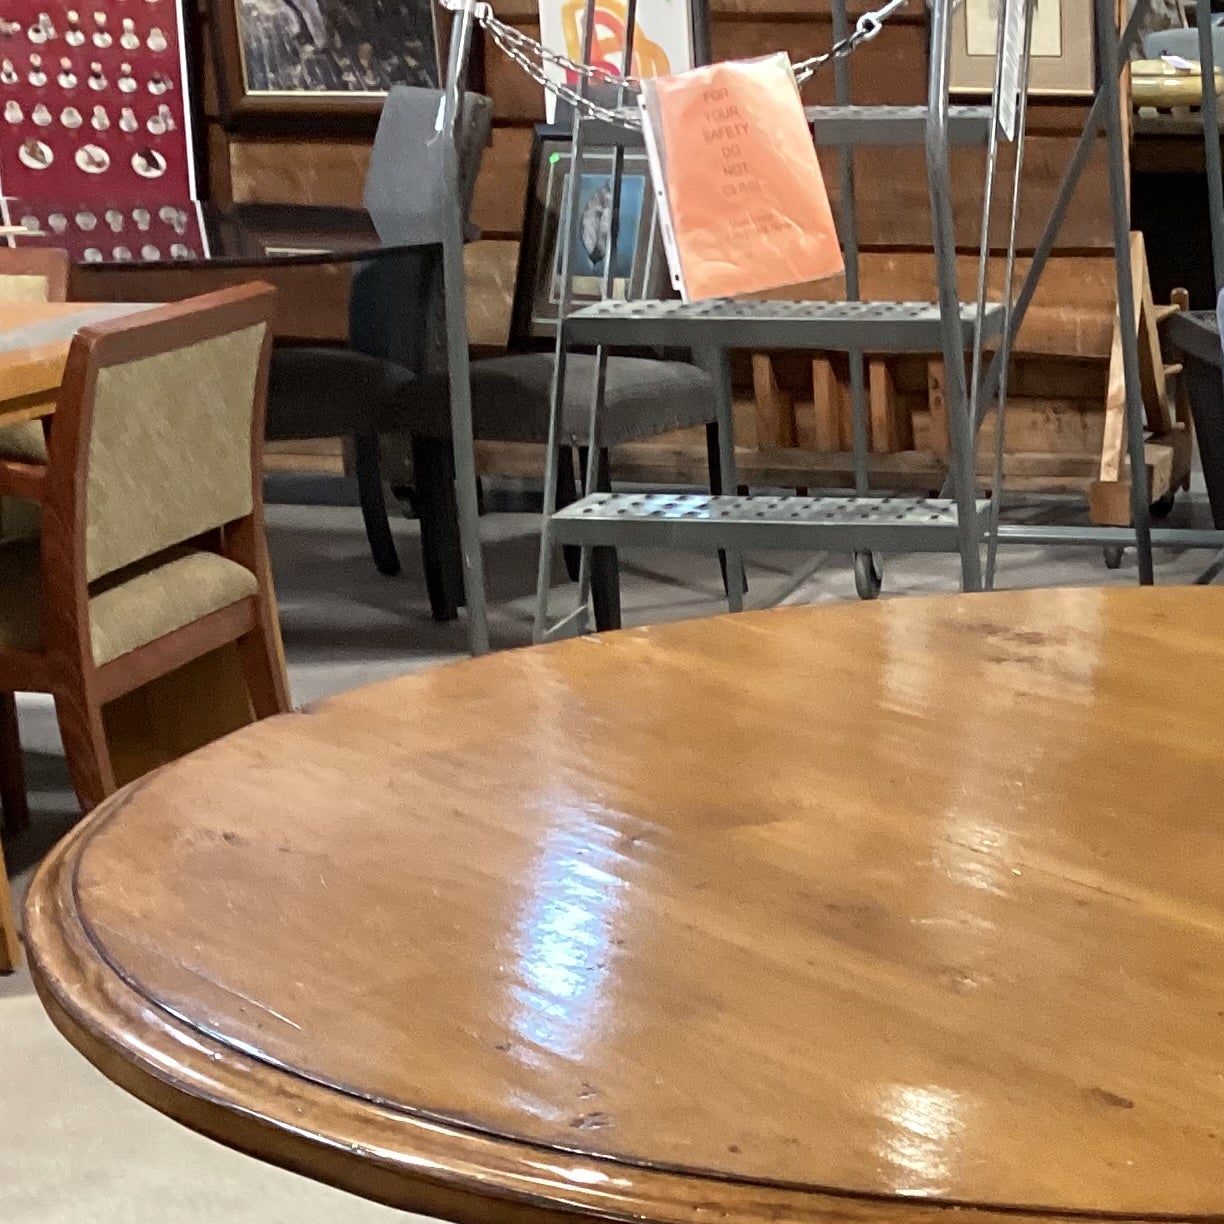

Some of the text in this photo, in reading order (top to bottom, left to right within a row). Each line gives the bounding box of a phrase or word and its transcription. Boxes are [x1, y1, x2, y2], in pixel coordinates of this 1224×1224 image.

[703, 88, 729, 103] FOR
[704, 105, 740, 121] YOUR
[702, 123, 749, 142] SAFETY
[721, 144, 741, 159] DO
[722, 162, 748, 176] NOT
